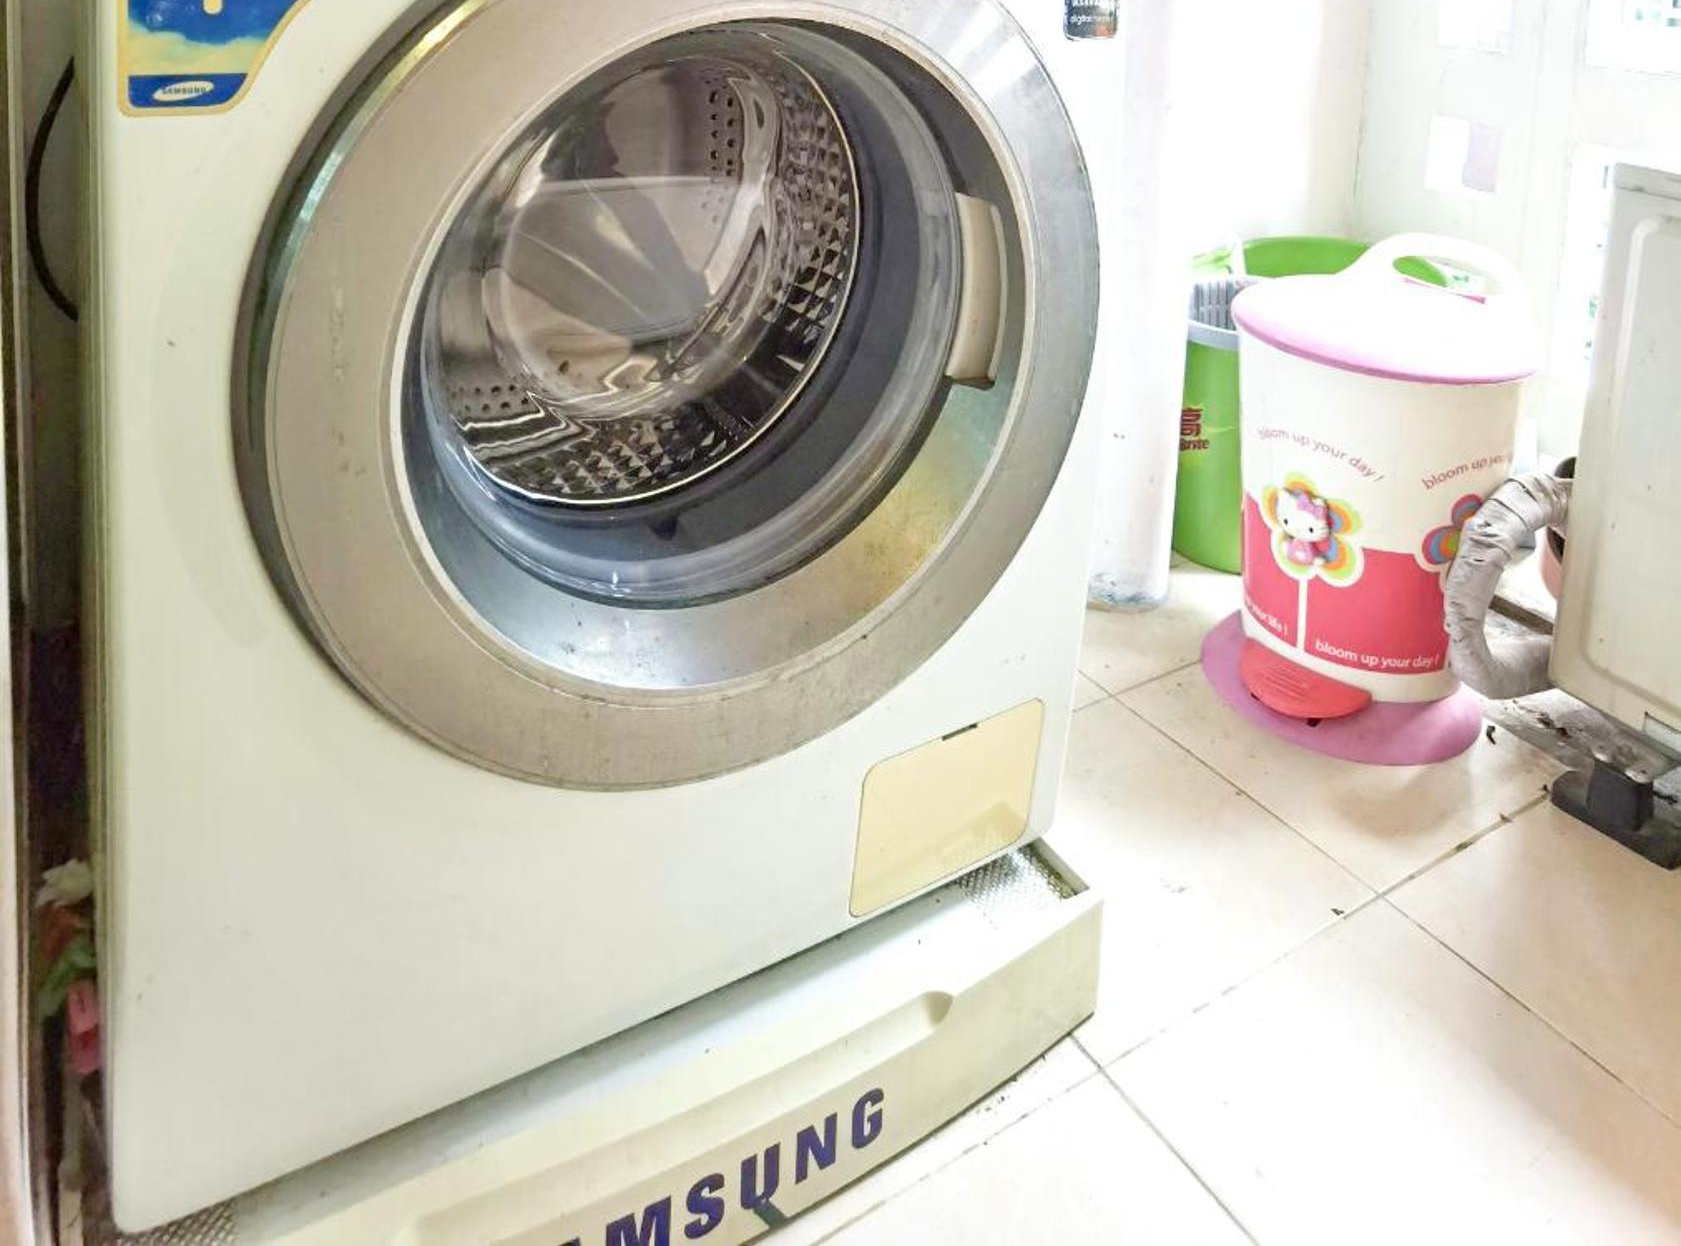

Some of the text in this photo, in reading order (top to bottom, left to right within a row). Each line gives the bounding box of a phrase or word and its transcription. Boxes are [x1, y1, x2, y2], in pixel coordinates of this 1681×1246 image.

[1292, 433, 1311, 446] up
[1312, 440, 1346, 460] your
[1421, 463, 1470, 489] bloom
[1471, 456, 1488, 470] up
[1314, 638, 1359, 662] bloom
[1360, 654, 1379, 668] up
[1380, 655, 1411, 668] your
[557, 1087, 884, 1246] MSUNG
